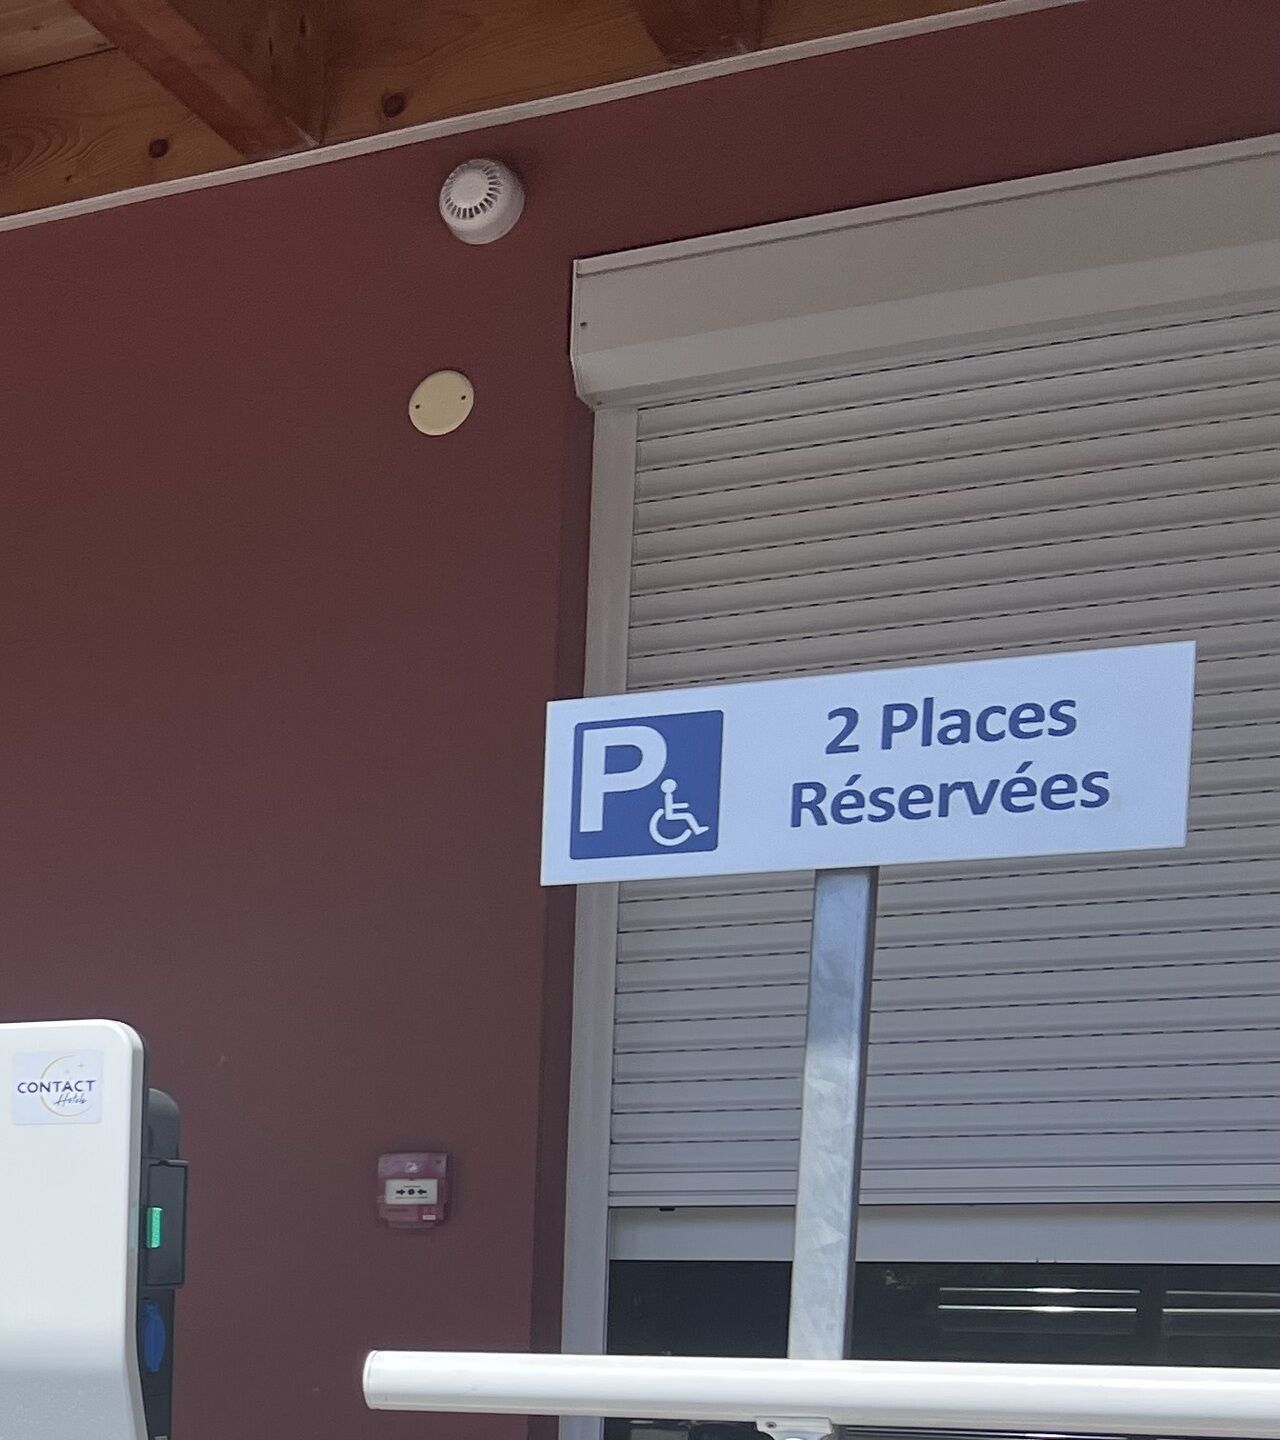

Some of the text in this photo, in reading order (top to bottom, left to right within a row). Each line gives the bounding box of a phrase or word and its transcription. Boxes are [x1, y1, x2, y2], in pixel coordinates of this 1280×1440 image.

[824, 697, 1079, 757] 2 Places
[578, 724, 668, 834] P
[789, 761, 1111, 829] Réservées
[16, 1079, 97, 1095] CONTACT
